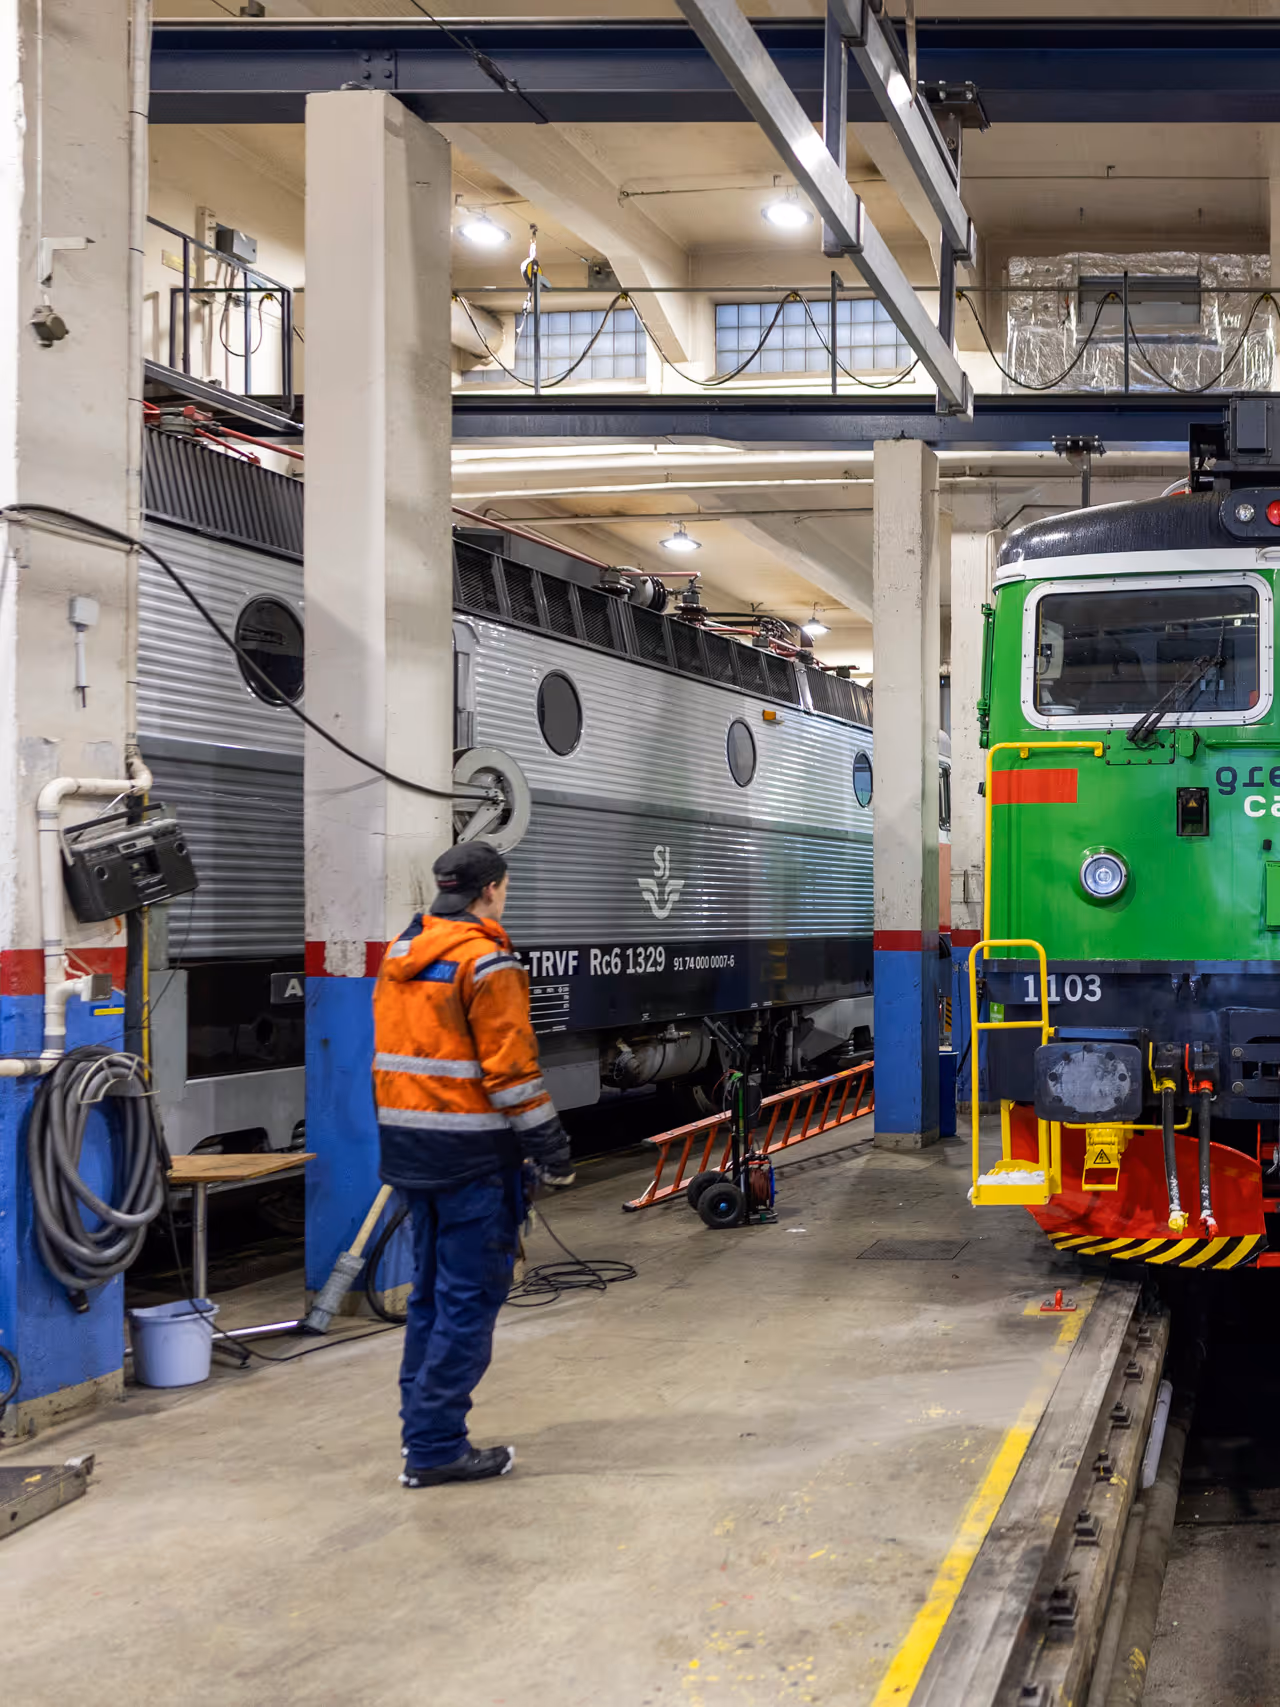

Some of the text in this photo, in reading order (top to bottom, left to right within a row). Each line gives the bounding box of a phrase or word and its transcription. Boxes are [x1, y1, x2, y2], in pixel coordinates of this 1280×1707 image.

[652, 844, 671, 880] SJ
[589, 947, 622, 976] Rc6
[625, 946, 666, 975] 1329
[673, 957, 684, 971] 91
[685, 956, 695, 970] 74
[695, 955, 709, 969] 000
[710, 954, 735, 968] 0007-6
[283, 977, 305, 998] A
[1023, 974, 1102, 1002] 1103
